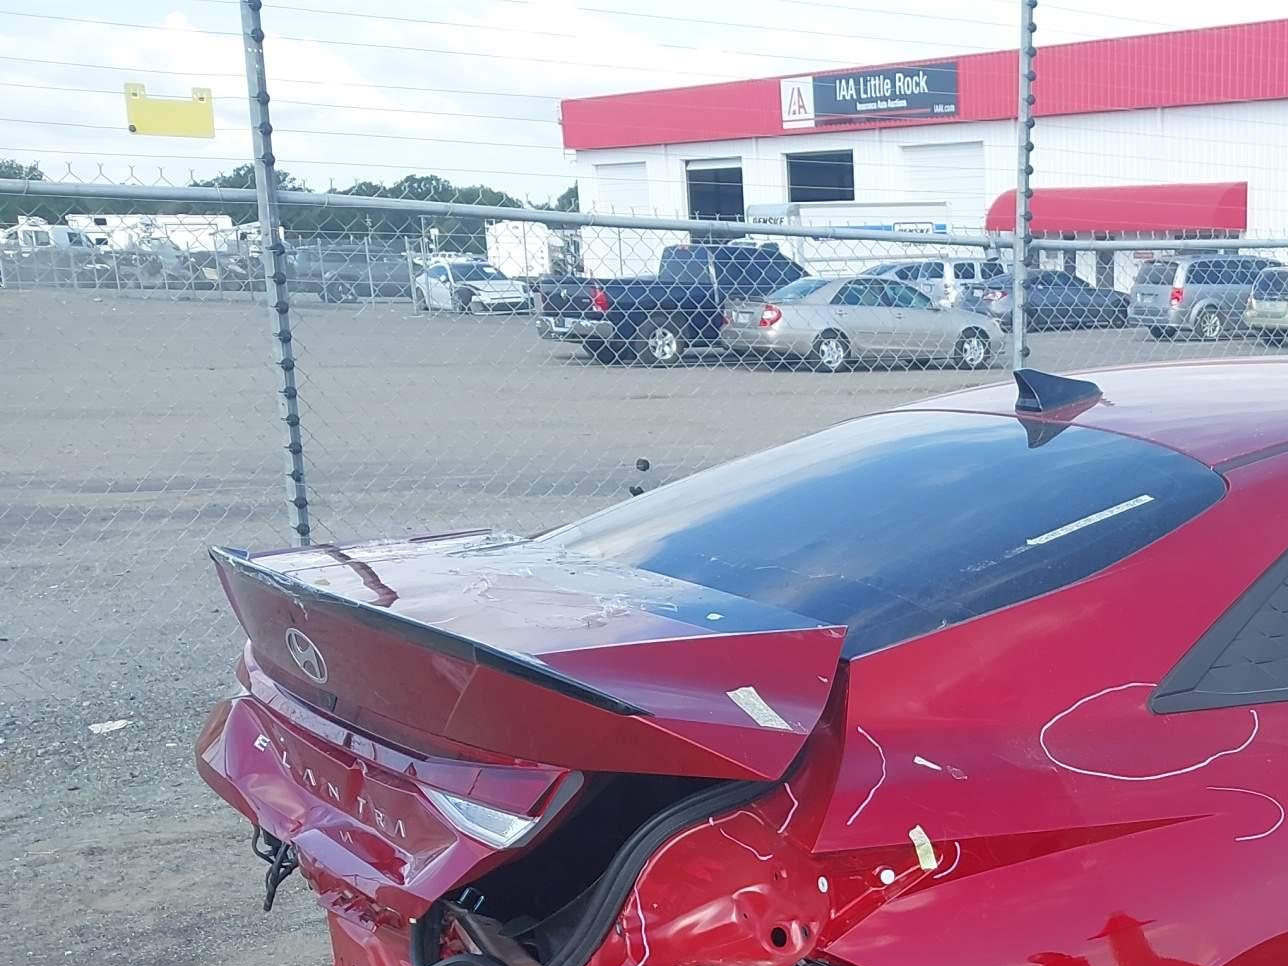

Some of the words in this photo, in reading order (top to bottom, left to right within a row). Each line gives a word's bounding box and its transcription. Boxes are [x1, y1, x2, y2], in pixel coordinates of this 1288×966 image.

[836, 77, 857, 100] IAA
[860, 75, 892, 99] Little
[895, 71, 928, 95] Rock
